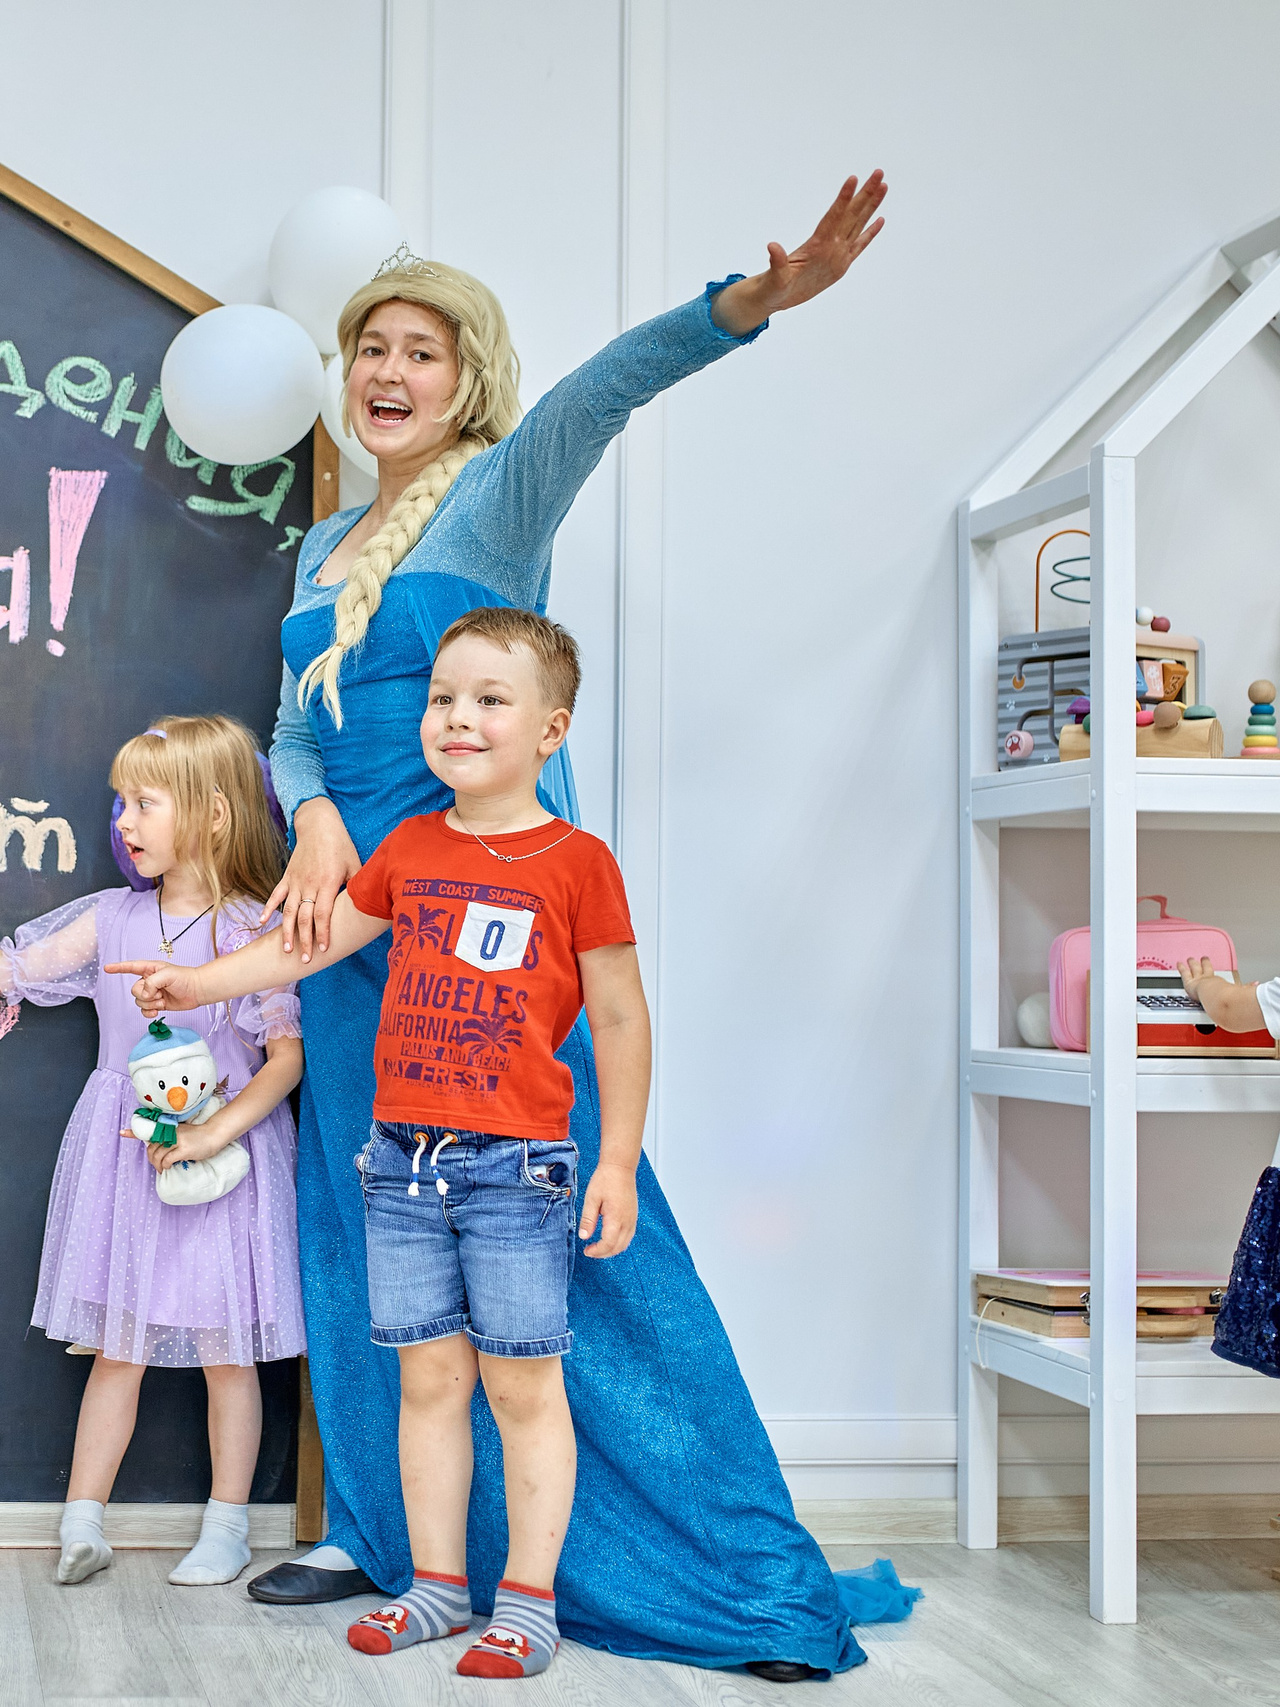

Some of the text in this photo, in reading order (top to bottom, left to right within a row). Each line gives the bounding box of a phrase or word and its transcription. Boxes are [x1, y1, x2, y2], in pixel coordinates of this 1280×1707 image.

[403, 881, 545, 913] WEST COAST SUMMER
[398, 971, 528, 1023] ANGELES
[420, 1063, 488, 1091] FRESH
